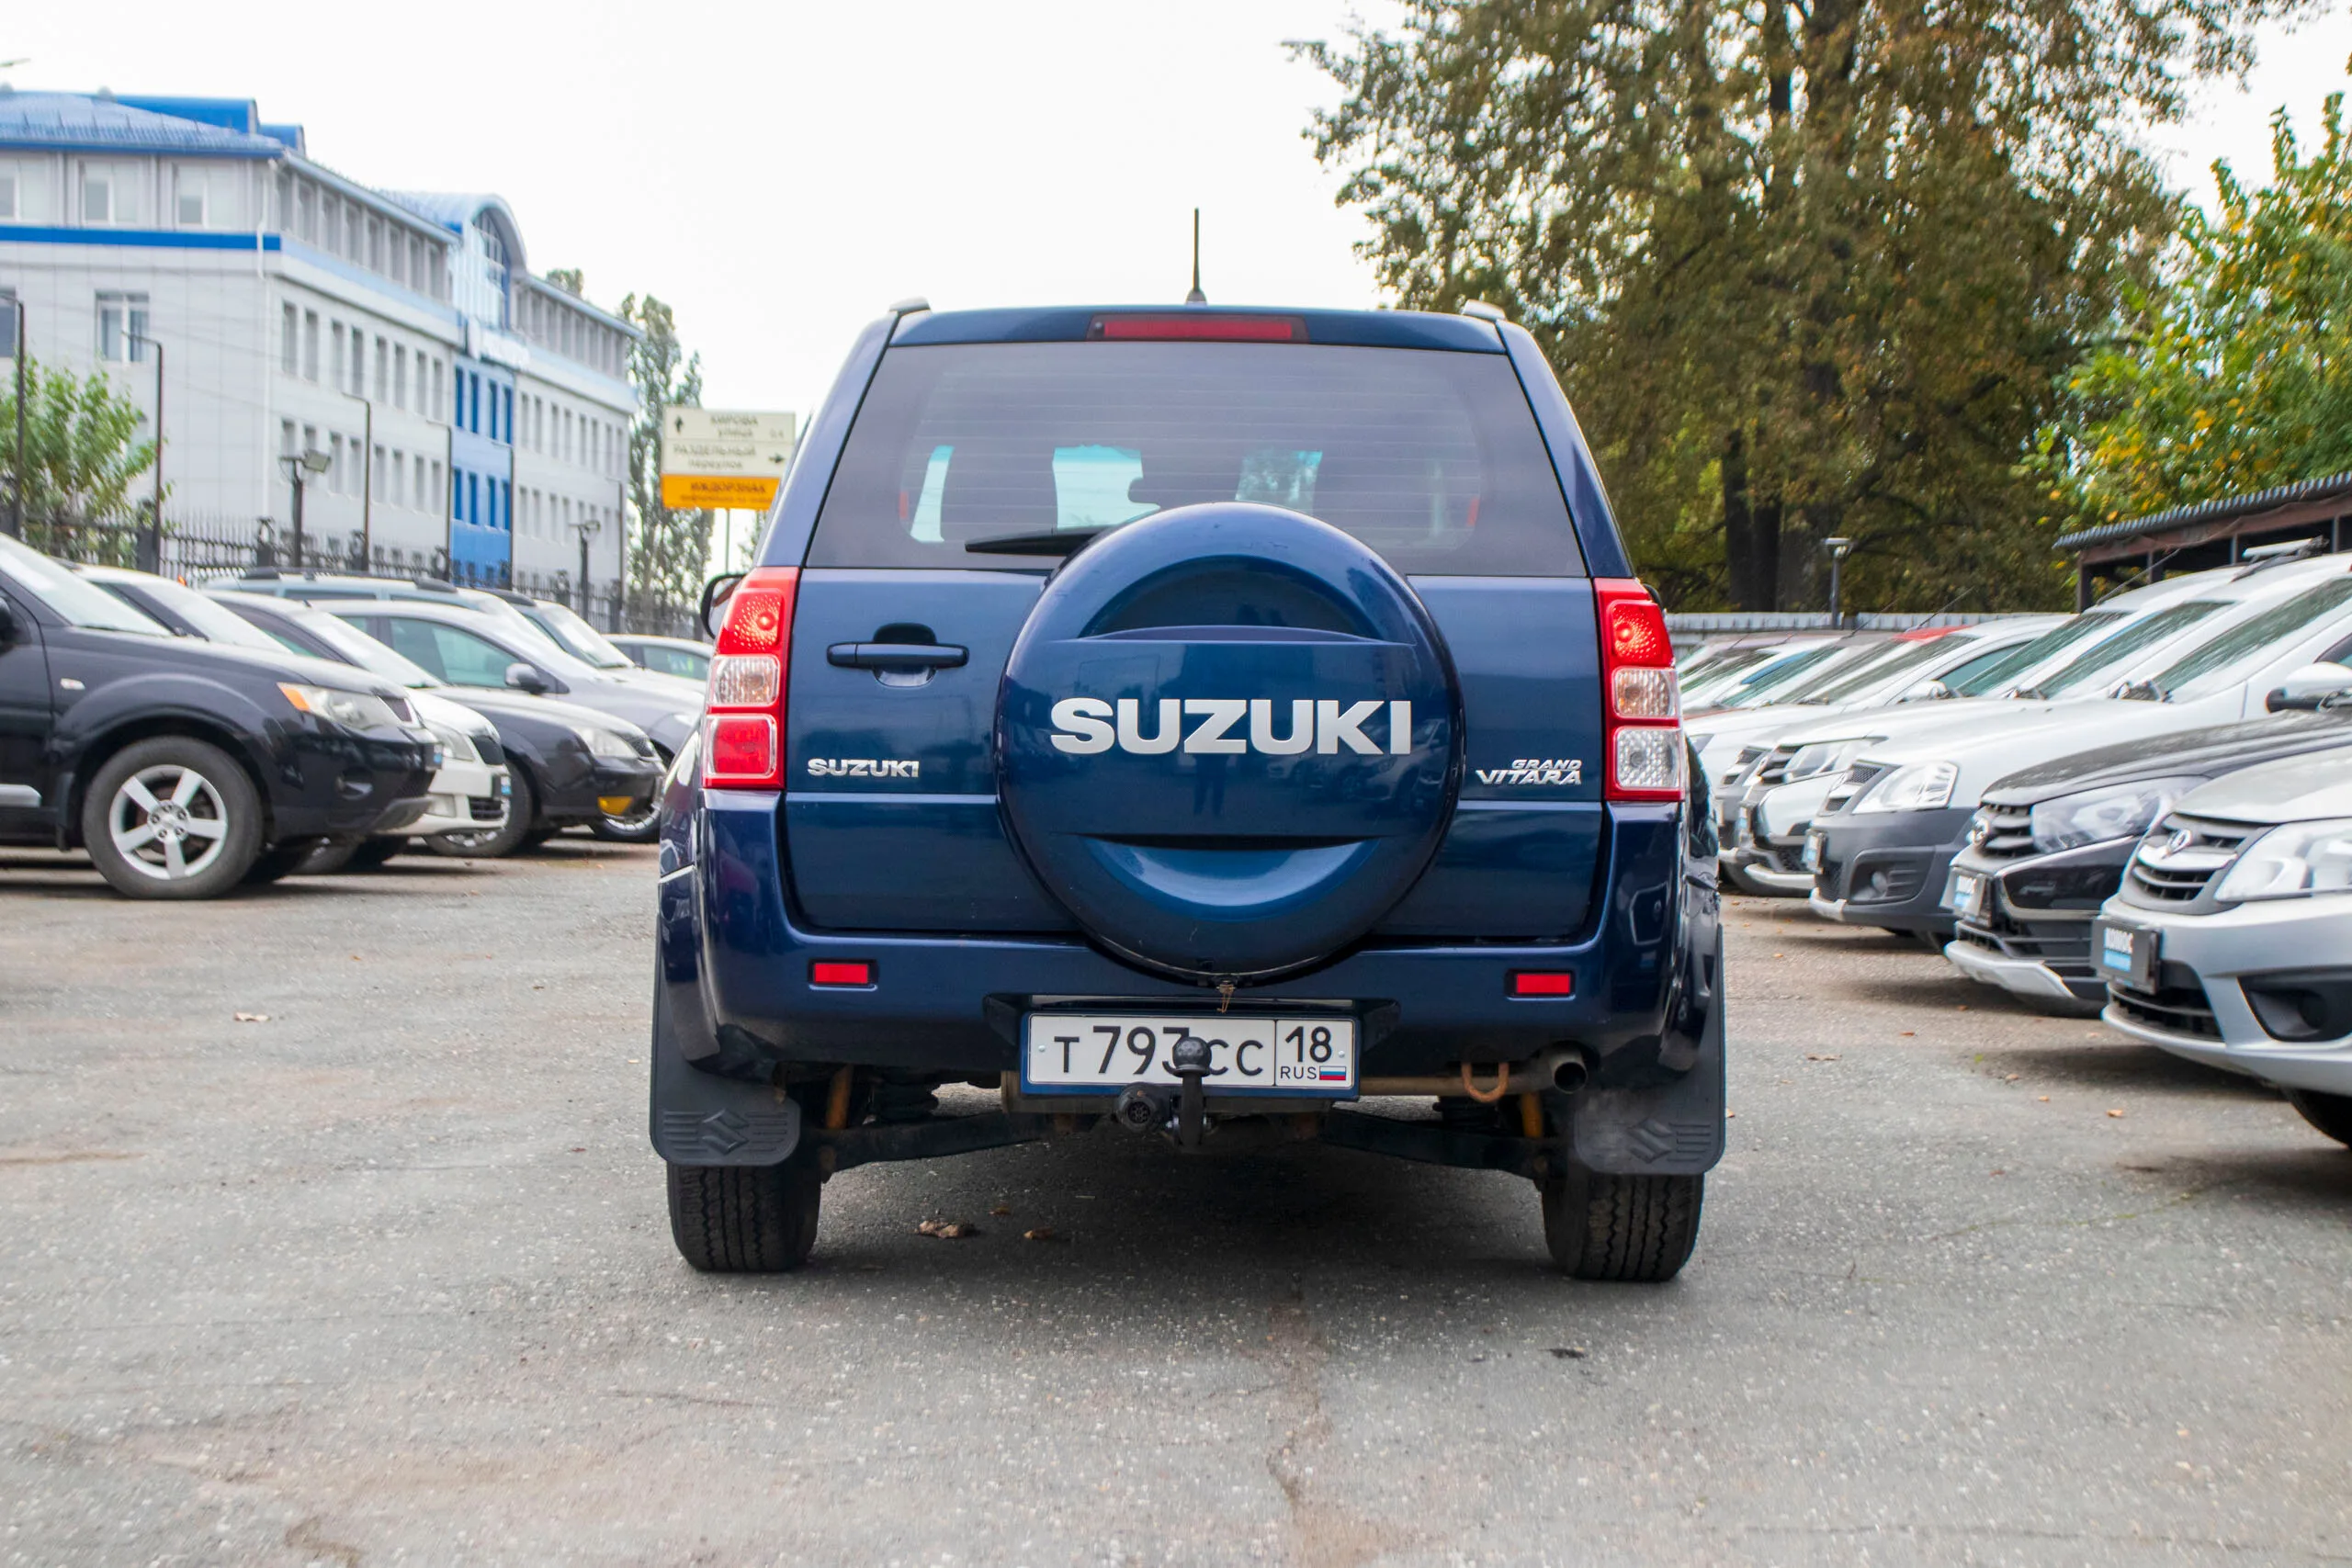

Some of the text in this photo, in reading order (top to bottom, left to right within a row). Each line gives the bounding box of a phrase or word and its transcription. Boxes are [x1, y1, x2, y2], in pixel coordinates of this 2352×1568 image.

[1050, 697, 1411, 755] SUZUKI
[807, 758, 920, 778] SUZUKI
[1511, 759, 1582, 770] GRAND
[1476, 769, 1582, 785] VITARA
[1284, 1025, 1332, 1063] 18
[1280, 1066, 1317, 1080] RUS
